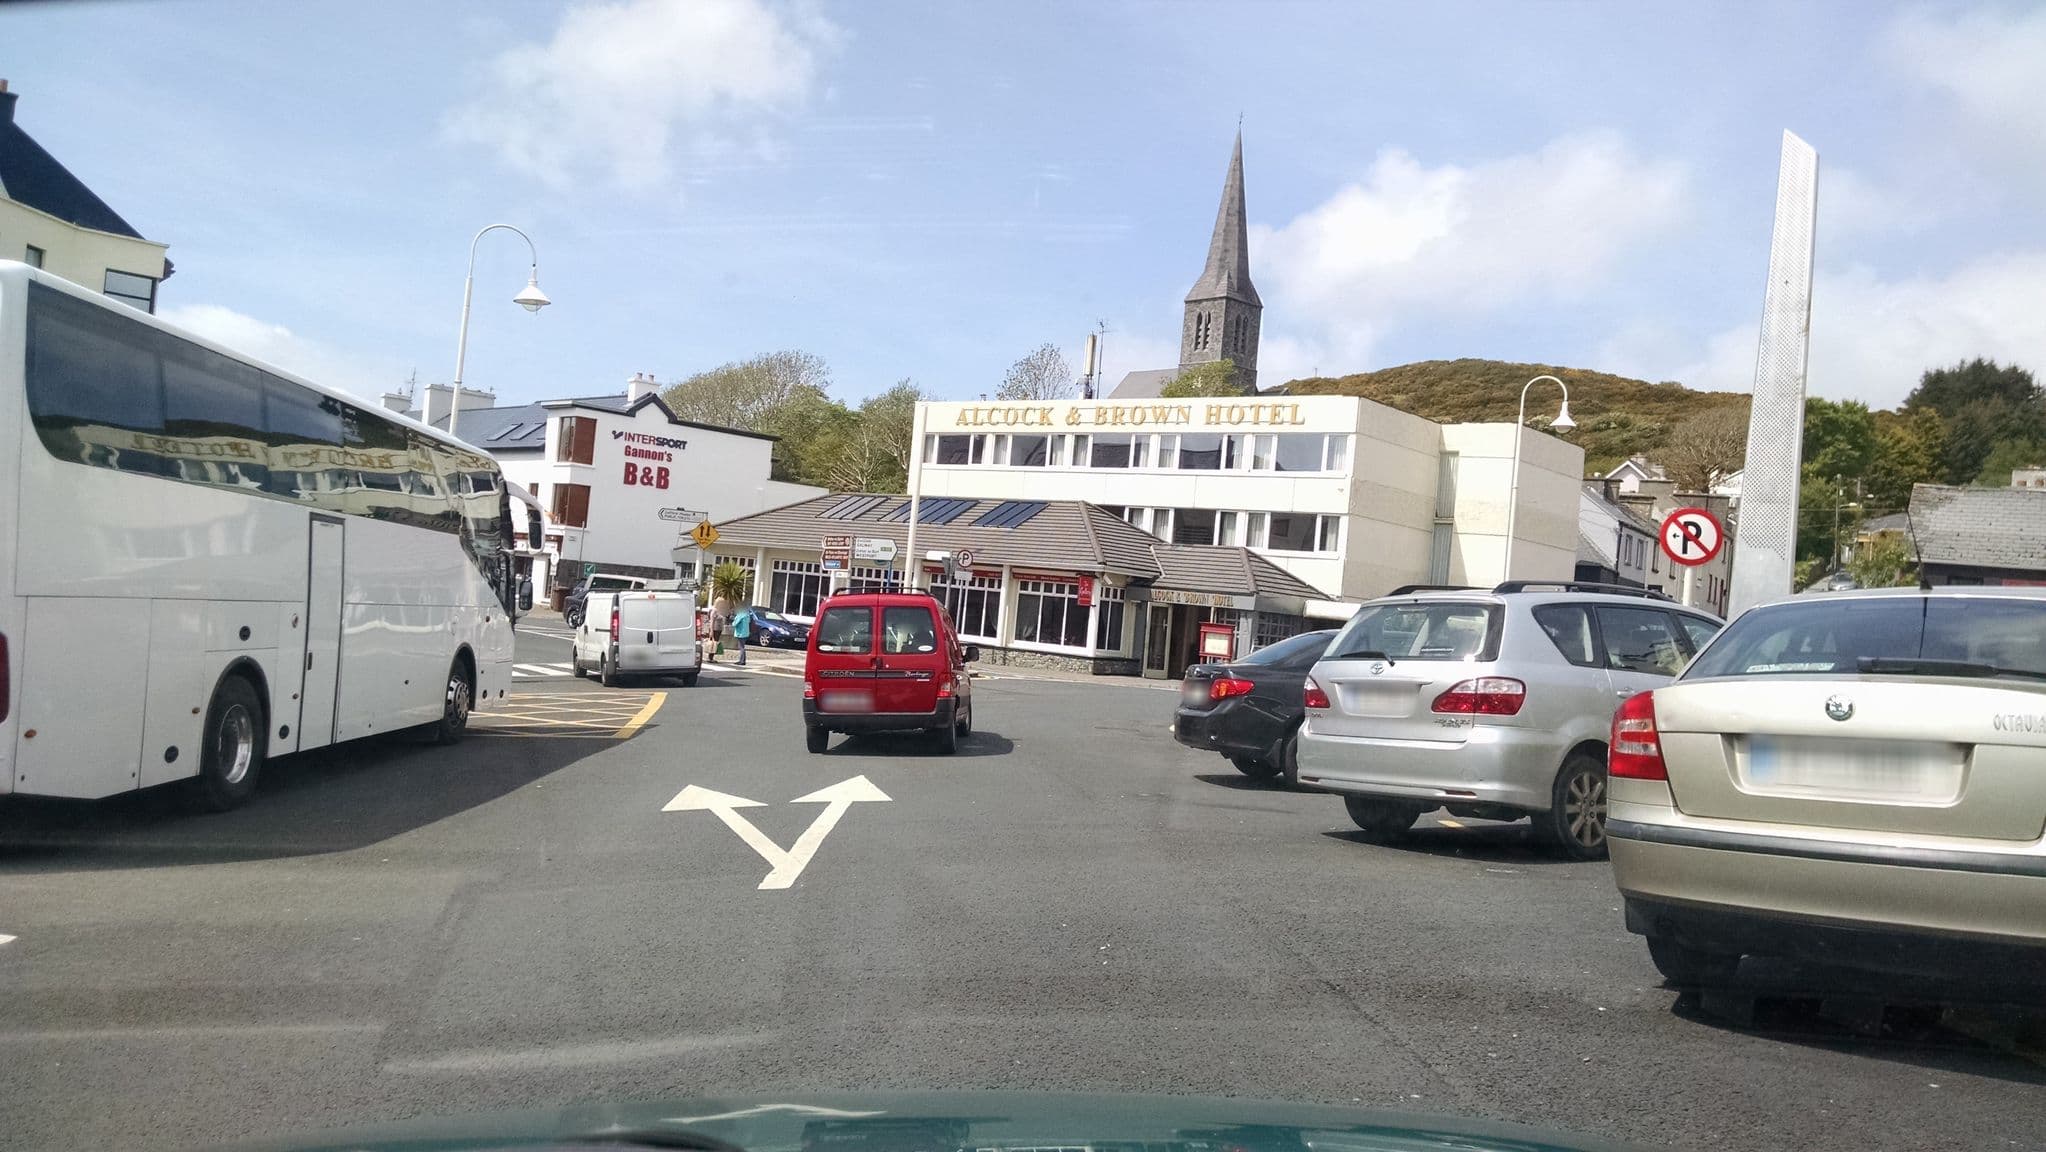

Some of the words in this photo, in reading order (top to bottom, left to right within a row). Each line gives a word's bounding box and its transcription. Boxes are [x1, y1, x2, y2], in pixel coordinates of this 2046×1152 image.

[955, 406, 1055, 426] ALCOCK
[1065, 406, 1081, 426] &
[1093, 405, 1192, 426] BROWN
[1204, 403, 1305, 426] HOTEL
[623, 431, 688, 450] INTERSPORT
[624, 444, 673, 463] Gannon's
